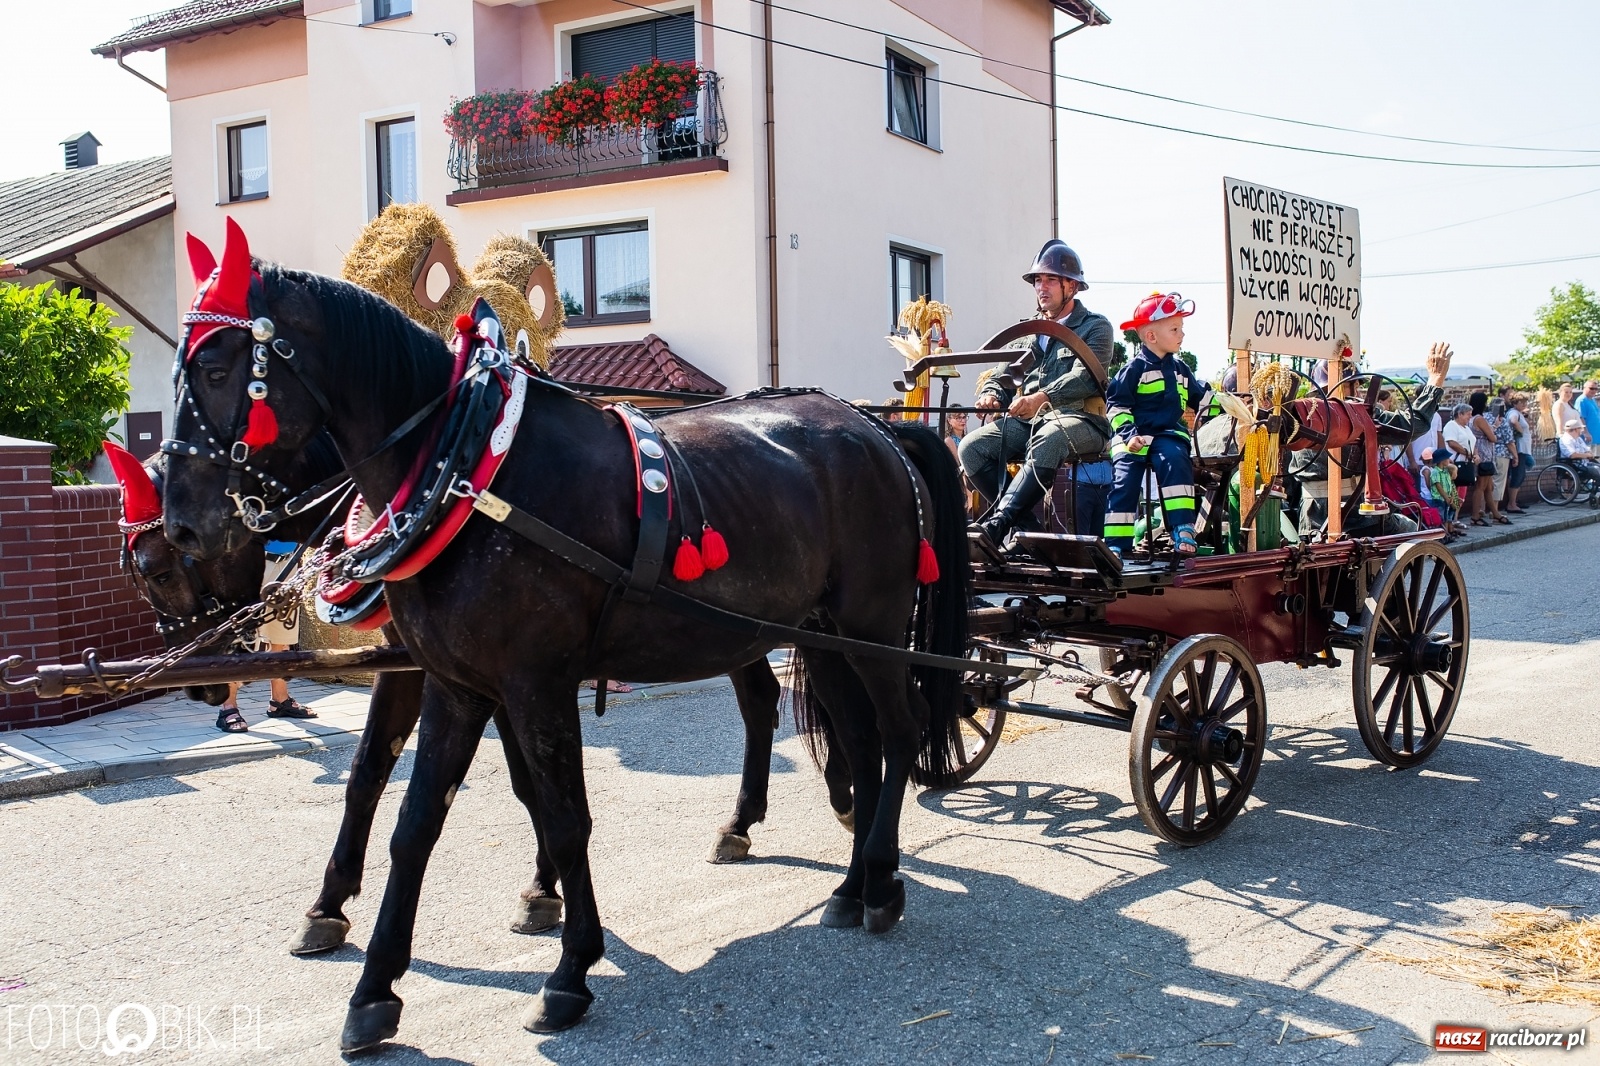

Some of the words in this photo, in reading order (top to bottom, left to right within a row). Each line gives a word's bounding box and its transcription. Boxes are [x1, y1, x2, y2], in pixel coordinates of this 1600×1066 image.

[1231, 185, 1289, 218] CHOCIAŻ
[1291, 197, 1345, 232] SPRZĘT
[789, 232, 799, 250] 13
[1252, 218, 1274, 243] NIE
[1280, 221, 1355, 268] PIERWSZEJ
[1239, 247, 1313, 278] MŁODOŚCI
[1320, 258, 1336, 282] DO
[1238, 273, 1290, 302] UŻYCIA
[1298, 280, 1361, 320] WCIĄGŁEJ
[1254, 307, 1336, 341] GOTOWOŚCI
